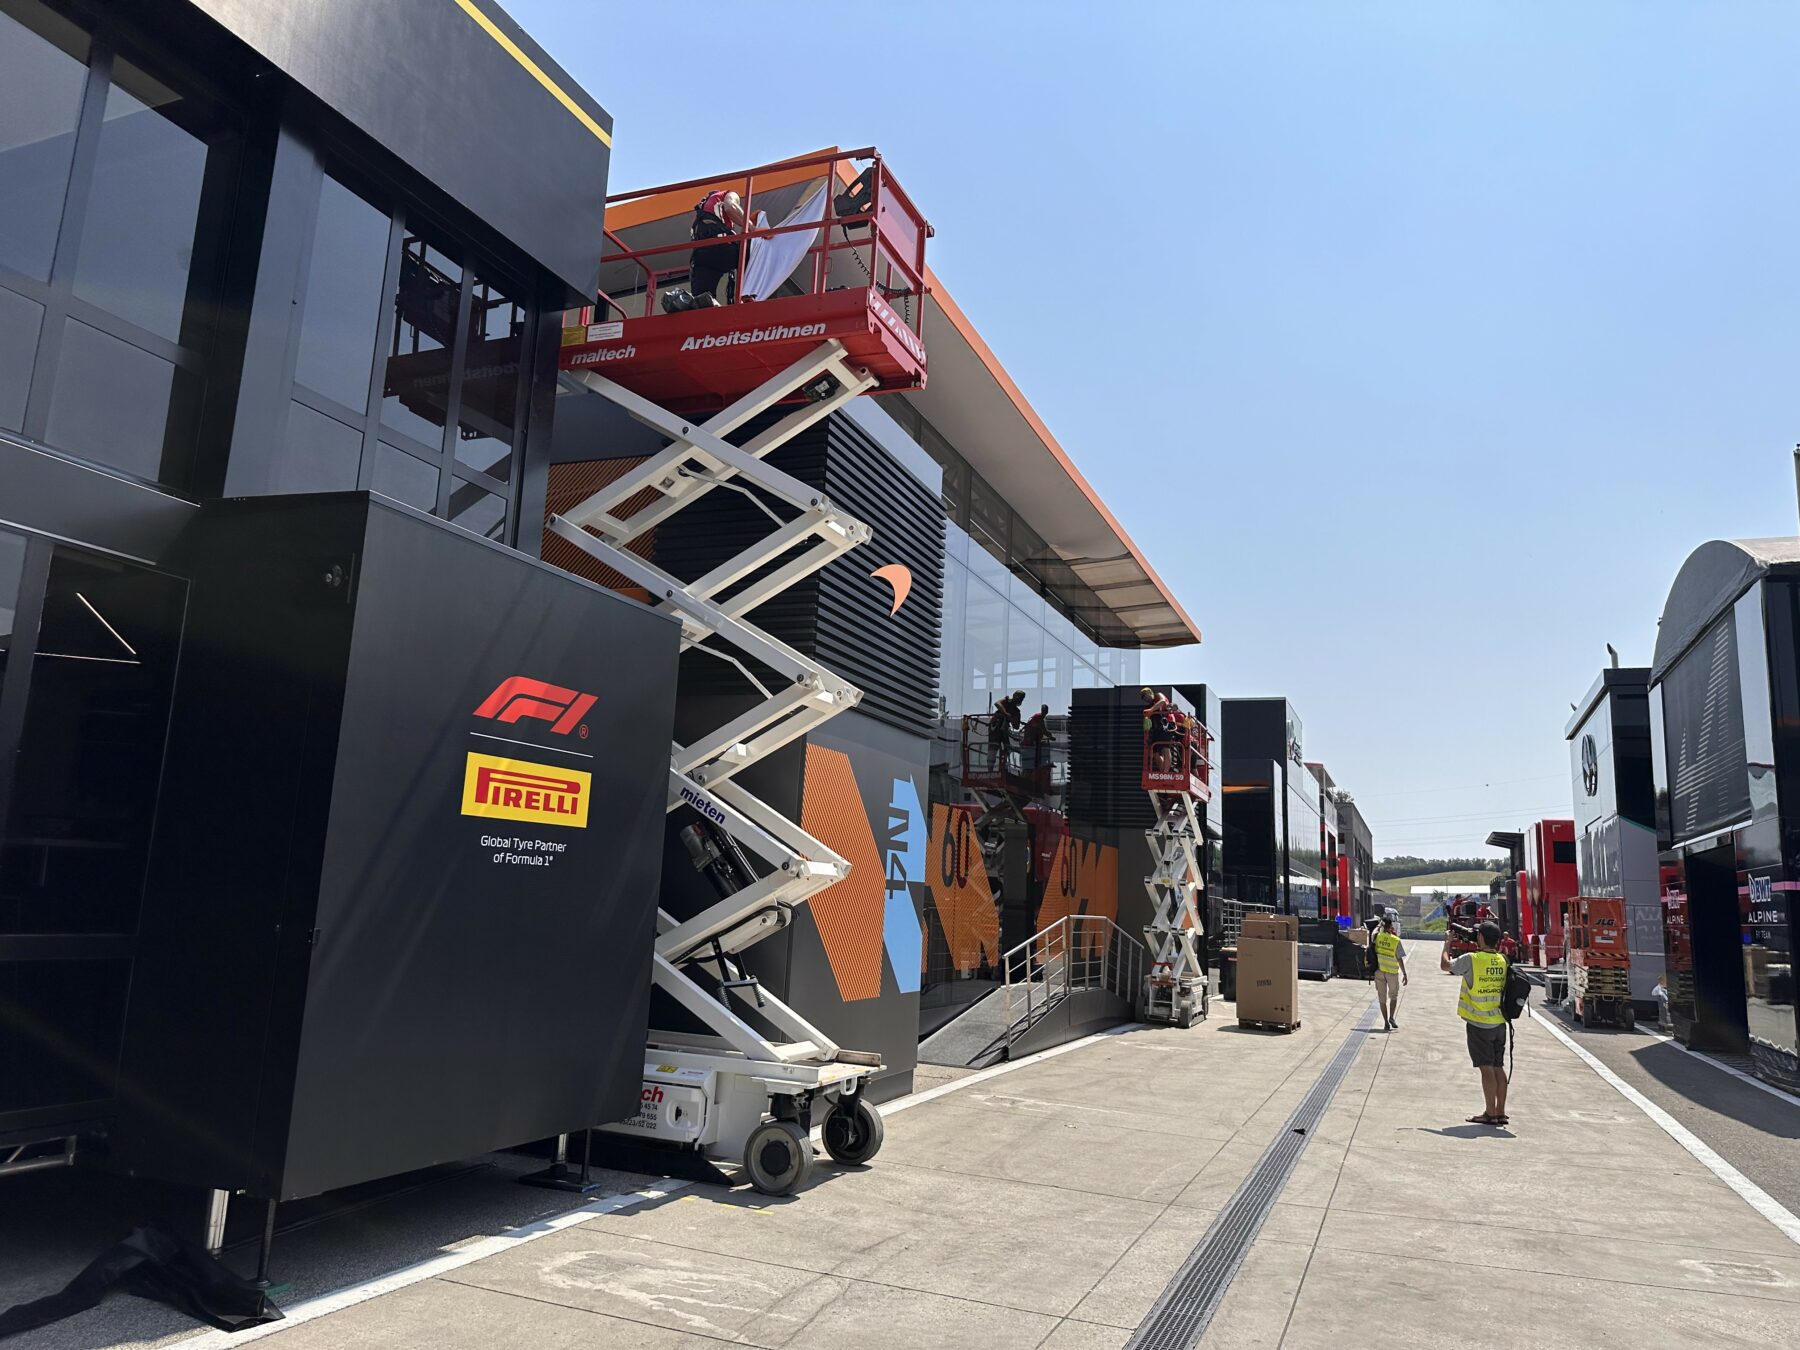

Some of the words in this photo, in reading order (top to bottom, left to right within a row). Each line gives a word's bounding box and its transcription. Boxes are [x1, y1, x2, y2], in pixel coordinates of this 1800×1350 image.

[571, 344, 636, 365] maltech
[680, 322, 826, 351] Arbeitsbühnen
[475, 766, 581, 815] PIRELLI
[680, 787, 726, 824] mieten
[480, 835, 511, 849] Global
[513, 837, 533, 851] Tyre
[535, 839, 567, 852] Partner
[493, 852, 504, 863] of
[505, 853, 543, 866] Formula
[1595, 918, 1615, 926] JLG
[1747, 910, 1778, 923] ALPINE
[1486, 967, 1504, 976] FOTO
[641, 1086, 664, 1103] ch
